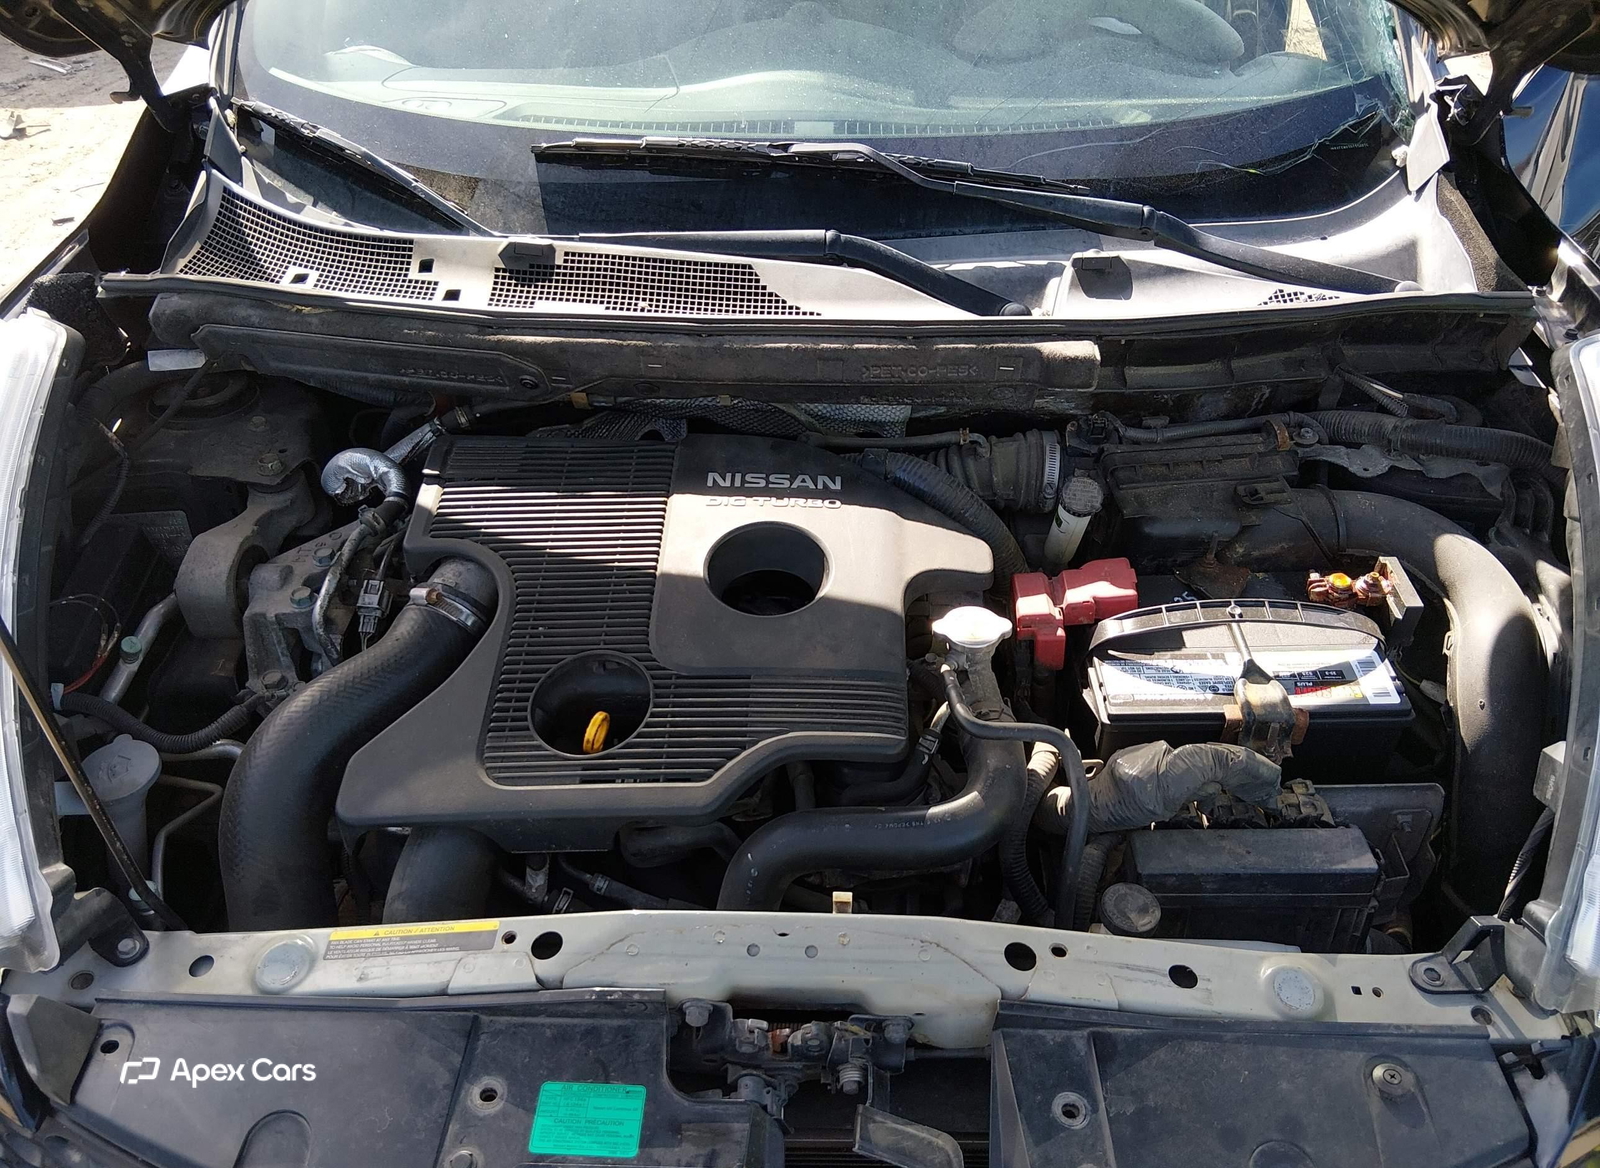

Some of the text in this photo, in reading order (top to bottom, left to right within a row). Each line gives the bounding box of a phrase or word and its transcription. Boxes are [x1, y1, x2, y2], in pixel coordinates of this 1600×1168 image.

[706, 472, 842, 490] NISSAN
[751, 496, 842, 509] TURBO
[384, 928, 413, 936] CAUTION
[577, 1085, 628, 1093] CONDITIONER
[584, 1118, 625, 1127] PRÉCAUTION
